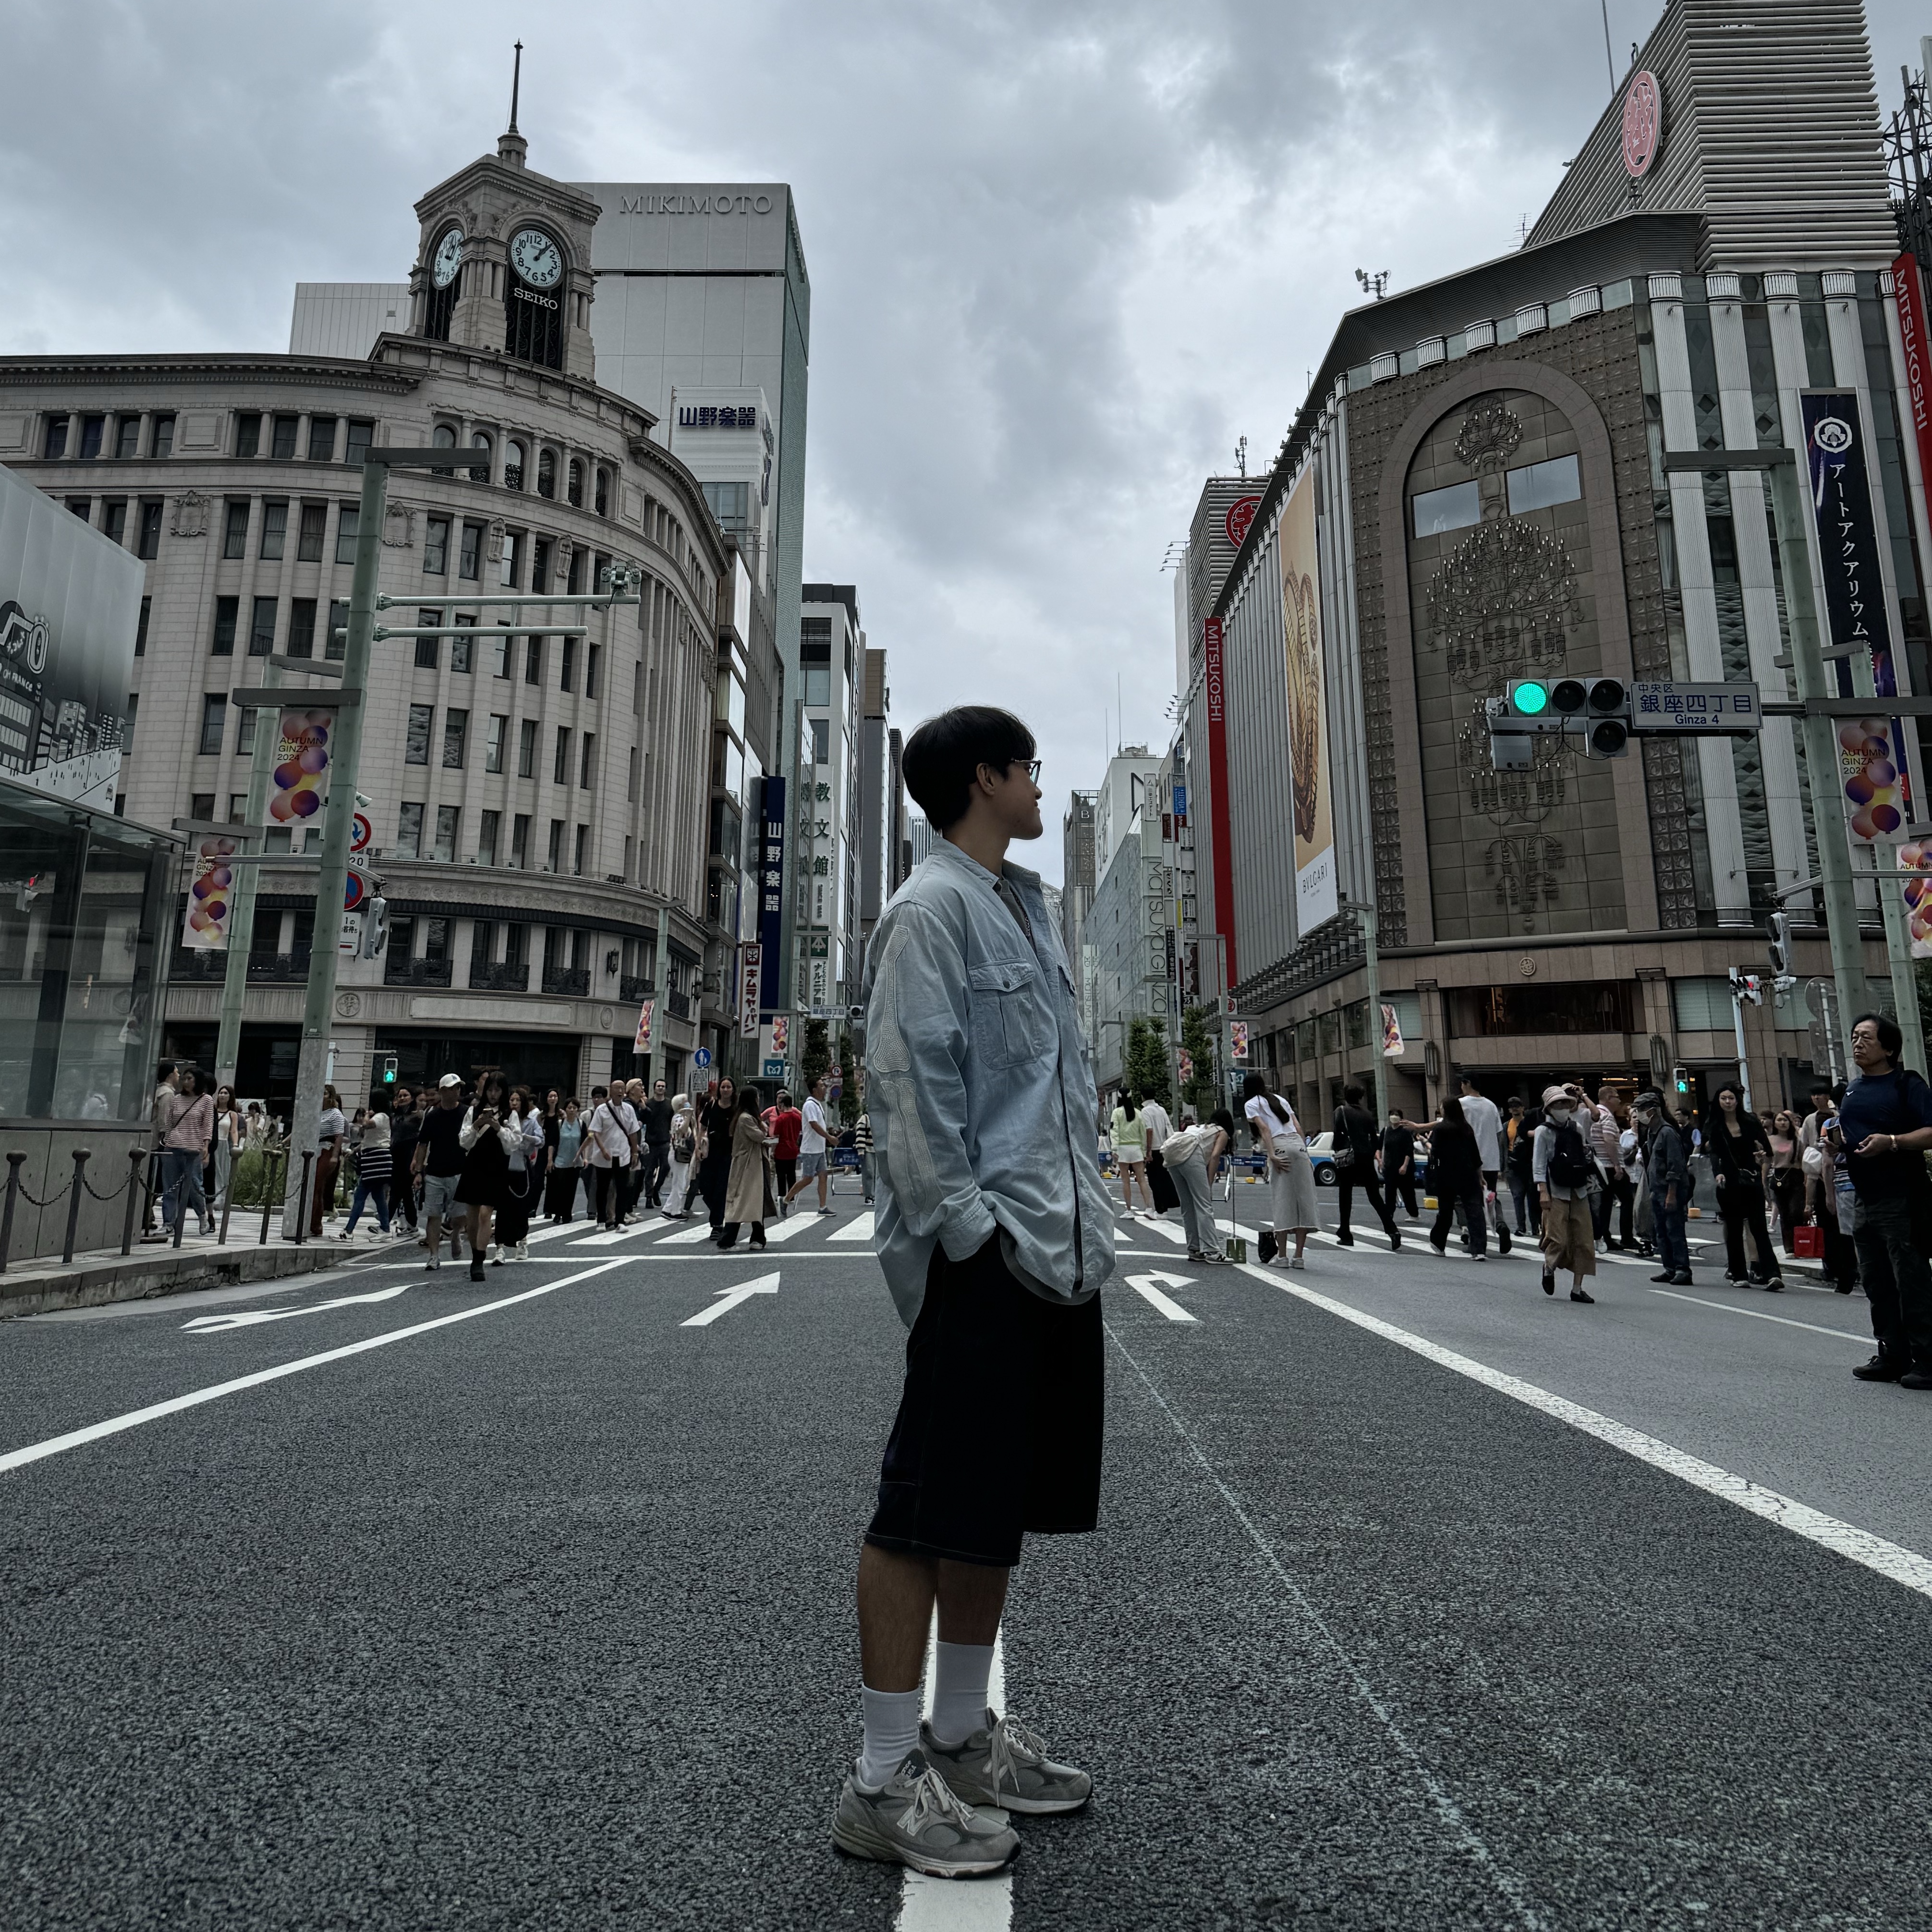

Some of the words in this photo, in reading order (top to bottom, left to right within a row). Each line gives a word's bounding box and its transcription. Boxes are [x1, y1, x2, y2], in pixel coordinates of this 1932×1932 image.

[620, 195, 772, 214] MIKIMOTO
[519, 239, 526, 248] 10
[526, 234, 533, 244] 11
[534, 235, 542, 245] 12
[515, 247, 522, 256] 9
[549, 250, 555, 259] 2
[518, 257, 524, 267] 8
[551, 260, 557, 269] 3
[446, 271, 450, 281] 6
[525, 266, 531, 276] 7
[547, 269, 554, 278] 4
[532, 272, 538, 281] 6
[540, 272, 547, 281] 5
[514, 288, 558, 310] SEIKO
[1896, 269, 1928, 430] MITSUKOSHI
[679, 406, 756, 426] 山野楽器
[1830, 464, 1869, 636] アートアクアリウム
[1207, 625, 1222, 721] MITSUKOSHI
[1638, 684, 1674, 693] 中央区
[1640, 695, 1751, 713] 銀座四丁目
[1675, 714, 1706, 724] Ginza
[1712, 715, 1719, 724] 4
[813, 781, 830, 876] 教文館
[765, 822, 782, 911] 山野楽器
[1303, 862, 1327, 893] BVLGARI
[744, 968, 757, 1033] キムラヤのパン
